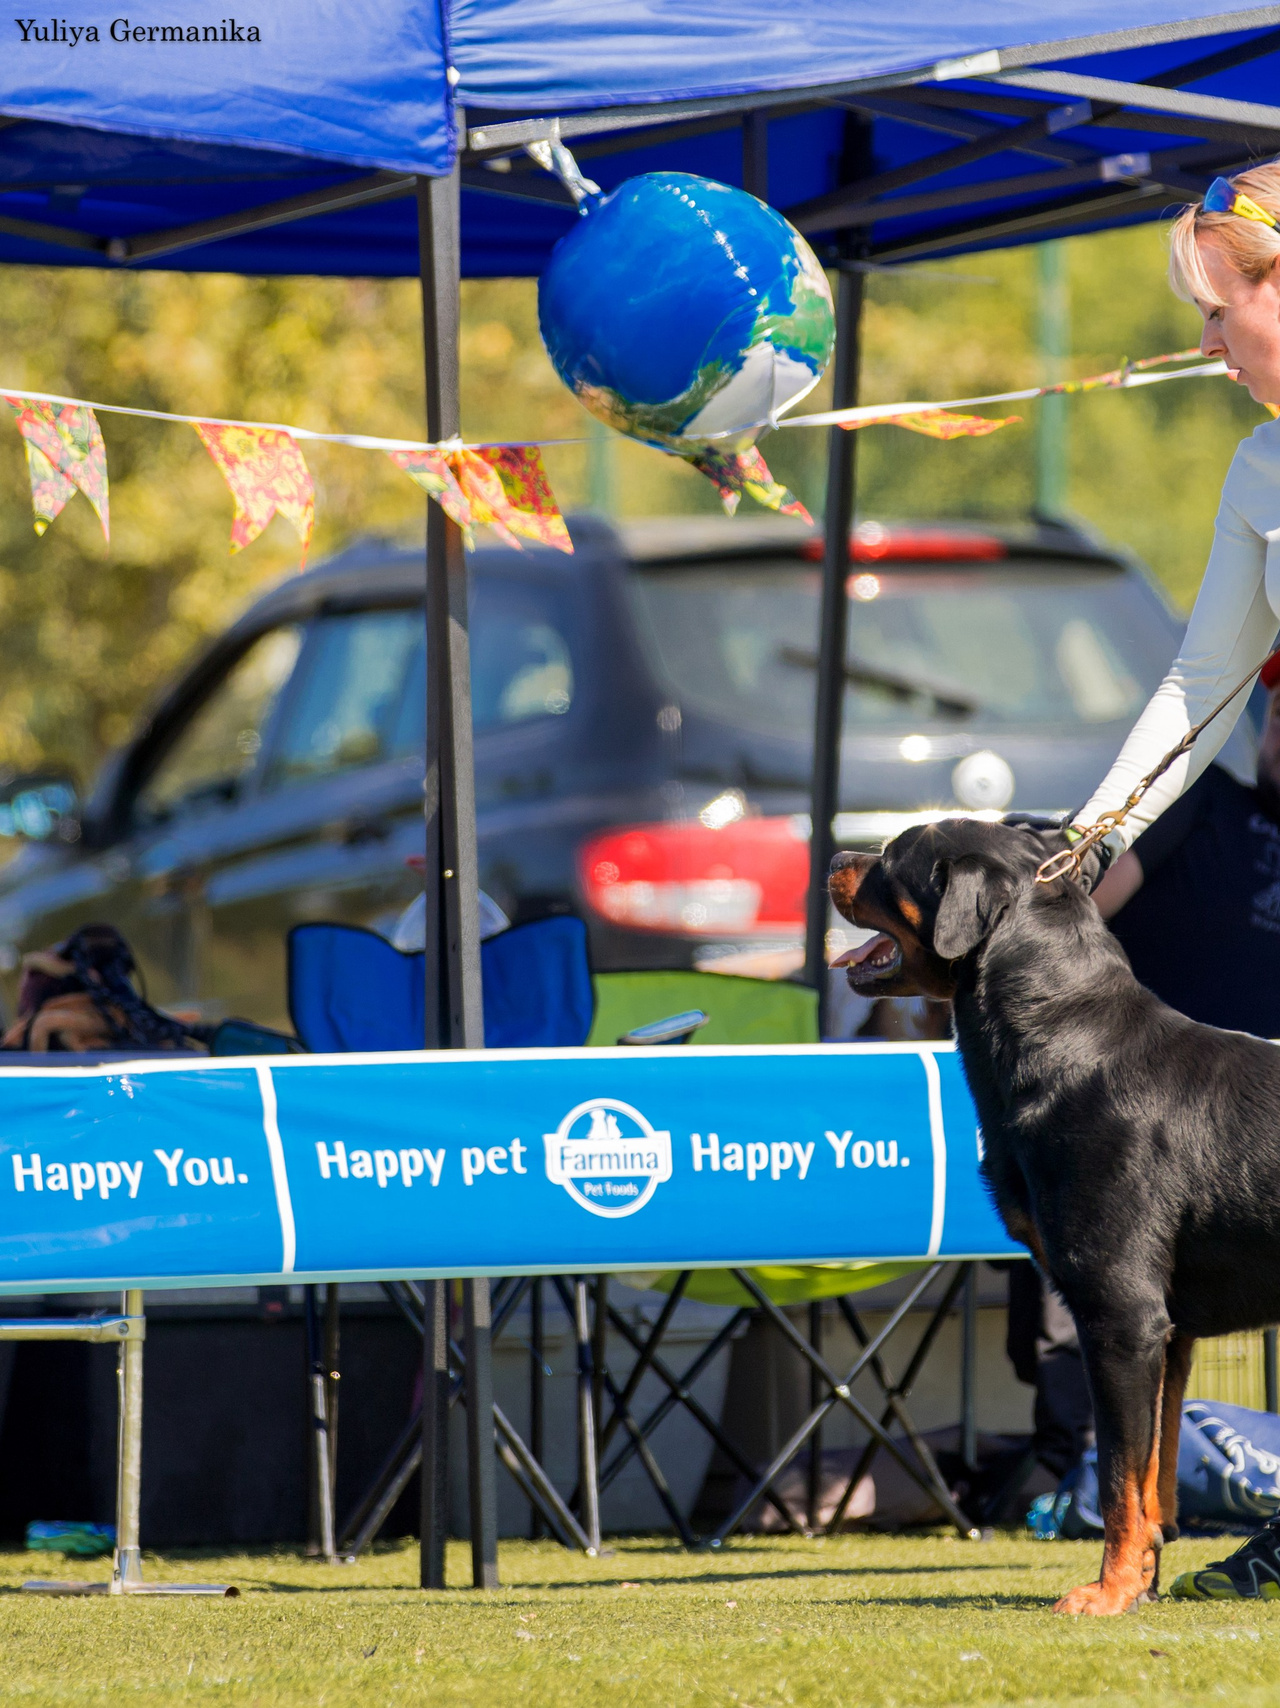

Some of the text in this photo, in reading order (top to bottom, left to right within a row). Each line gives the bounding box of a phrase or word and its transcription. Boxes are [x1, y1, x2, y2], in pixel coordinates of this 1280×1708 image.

[12, 1148, 249, 1201] Happy You.
[315, 1137, 528, 1189] Happy pet
[560, 1146, 659, 1171] Farmina
[690, 1130, 910, 1181] Happy You.
[583, 1181, 639, 1196] Pet Foods
